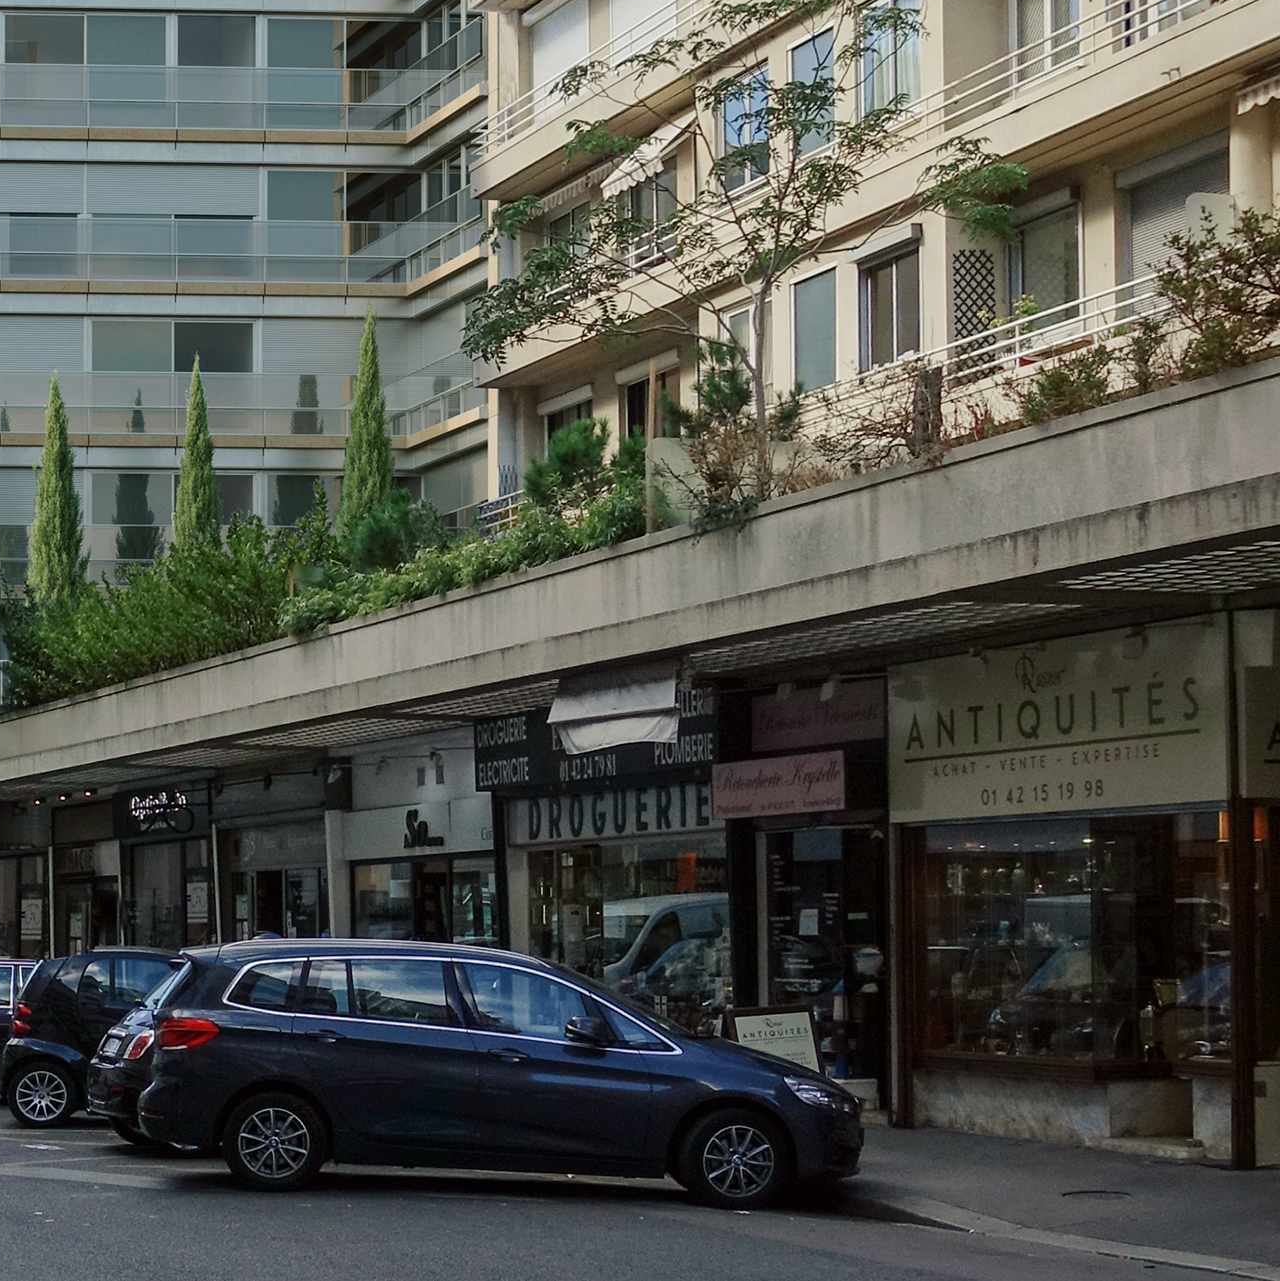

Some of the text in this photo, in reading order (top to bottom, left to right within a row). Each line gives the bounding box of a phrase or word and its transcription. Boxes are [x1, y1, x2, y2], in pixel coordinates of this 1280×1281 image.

[905, 671, 1200, 751] ANTIQUITÉS
[477, 715, 527, 748] DROGUERIE
[654, 732, 714, 765] PLOMBERIE
[932, 742, 1161, 778] ACHAT VENTE EXPERTISE
[478, 756, 530, 786] ELECTRICITE
[559, 754, 617, 782] 01 42 24 79 81
[980, 778, 1104, 806] 01 42 15 19 98
[528, 781, 710, 840] DROGUERIE
